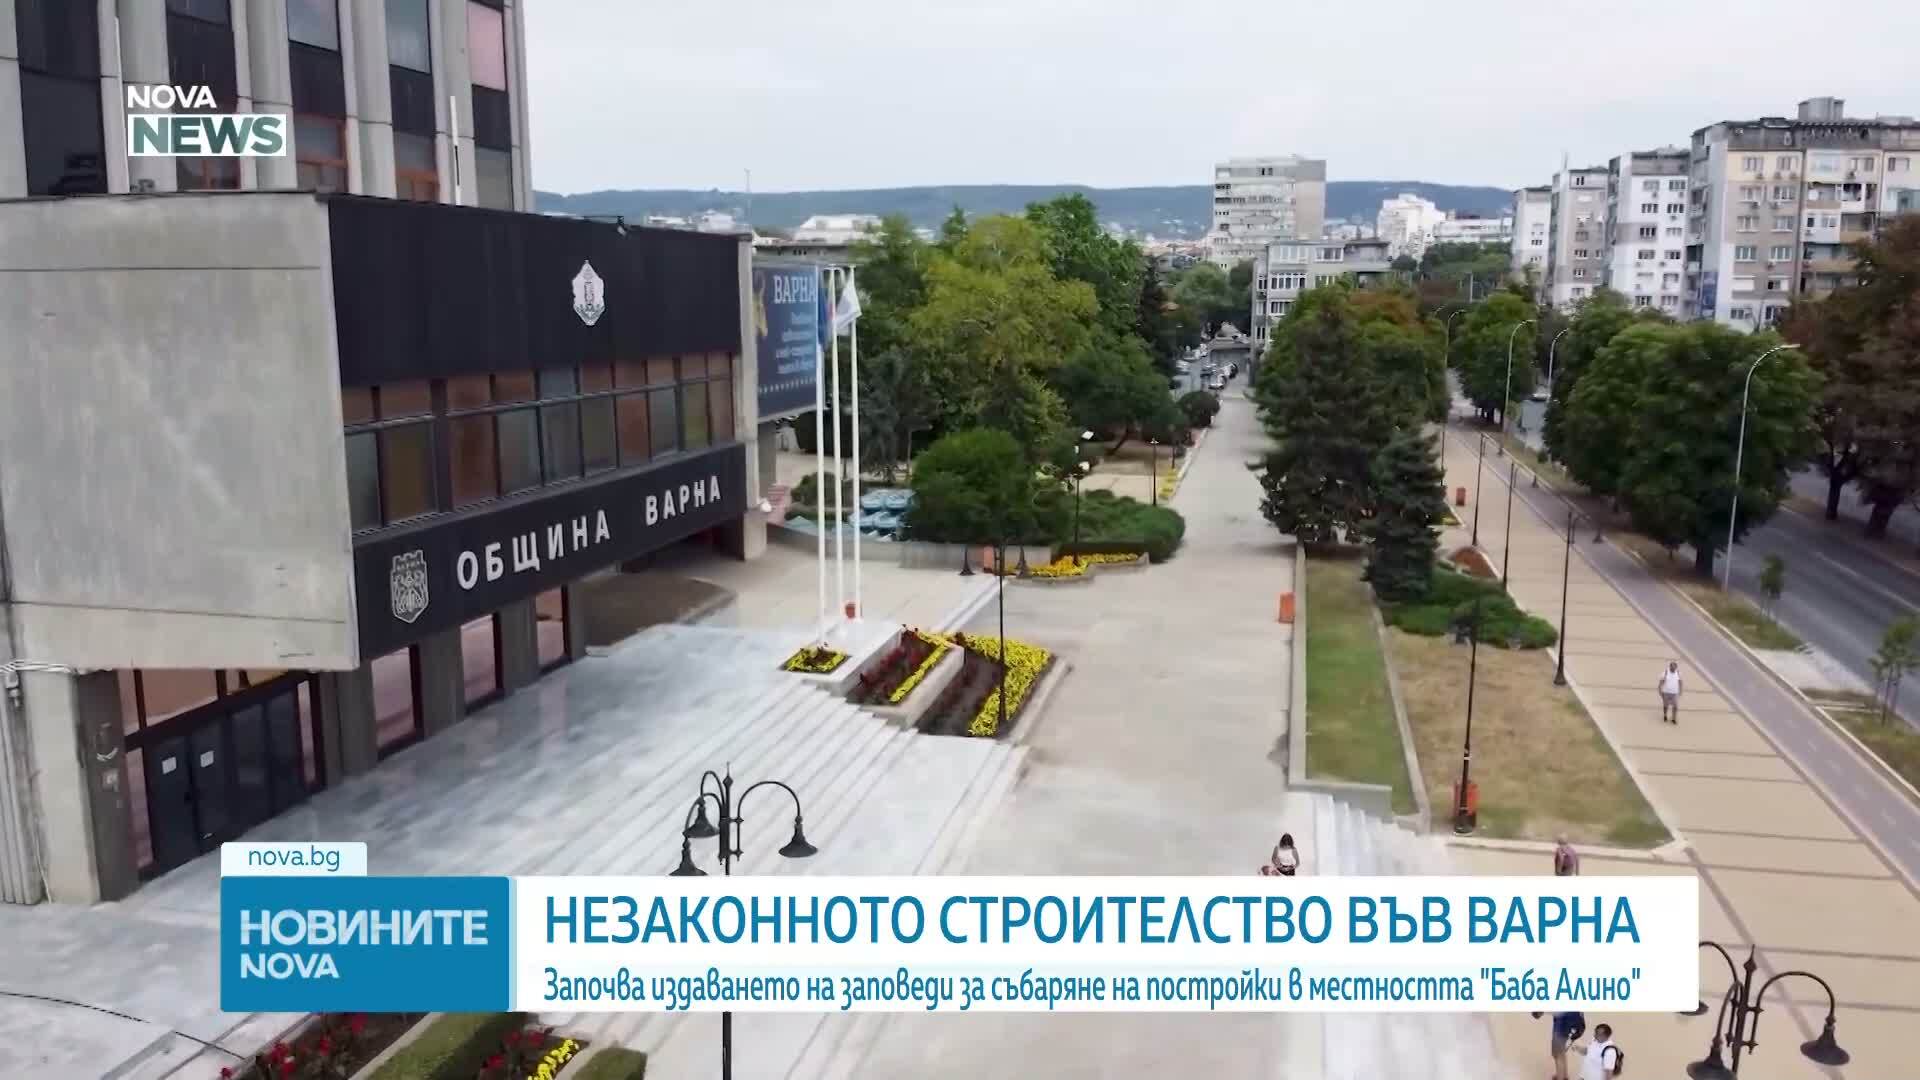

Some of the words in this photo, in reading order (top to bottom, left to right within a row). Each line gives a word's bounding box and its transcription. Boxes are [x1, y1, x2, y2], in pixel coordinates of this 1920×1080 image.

[773, 275, 817, 304] ВАРНА
[456, 509, 611, 590] ОБЩИНА
[645, 475, 722, 527] ВАРНА
